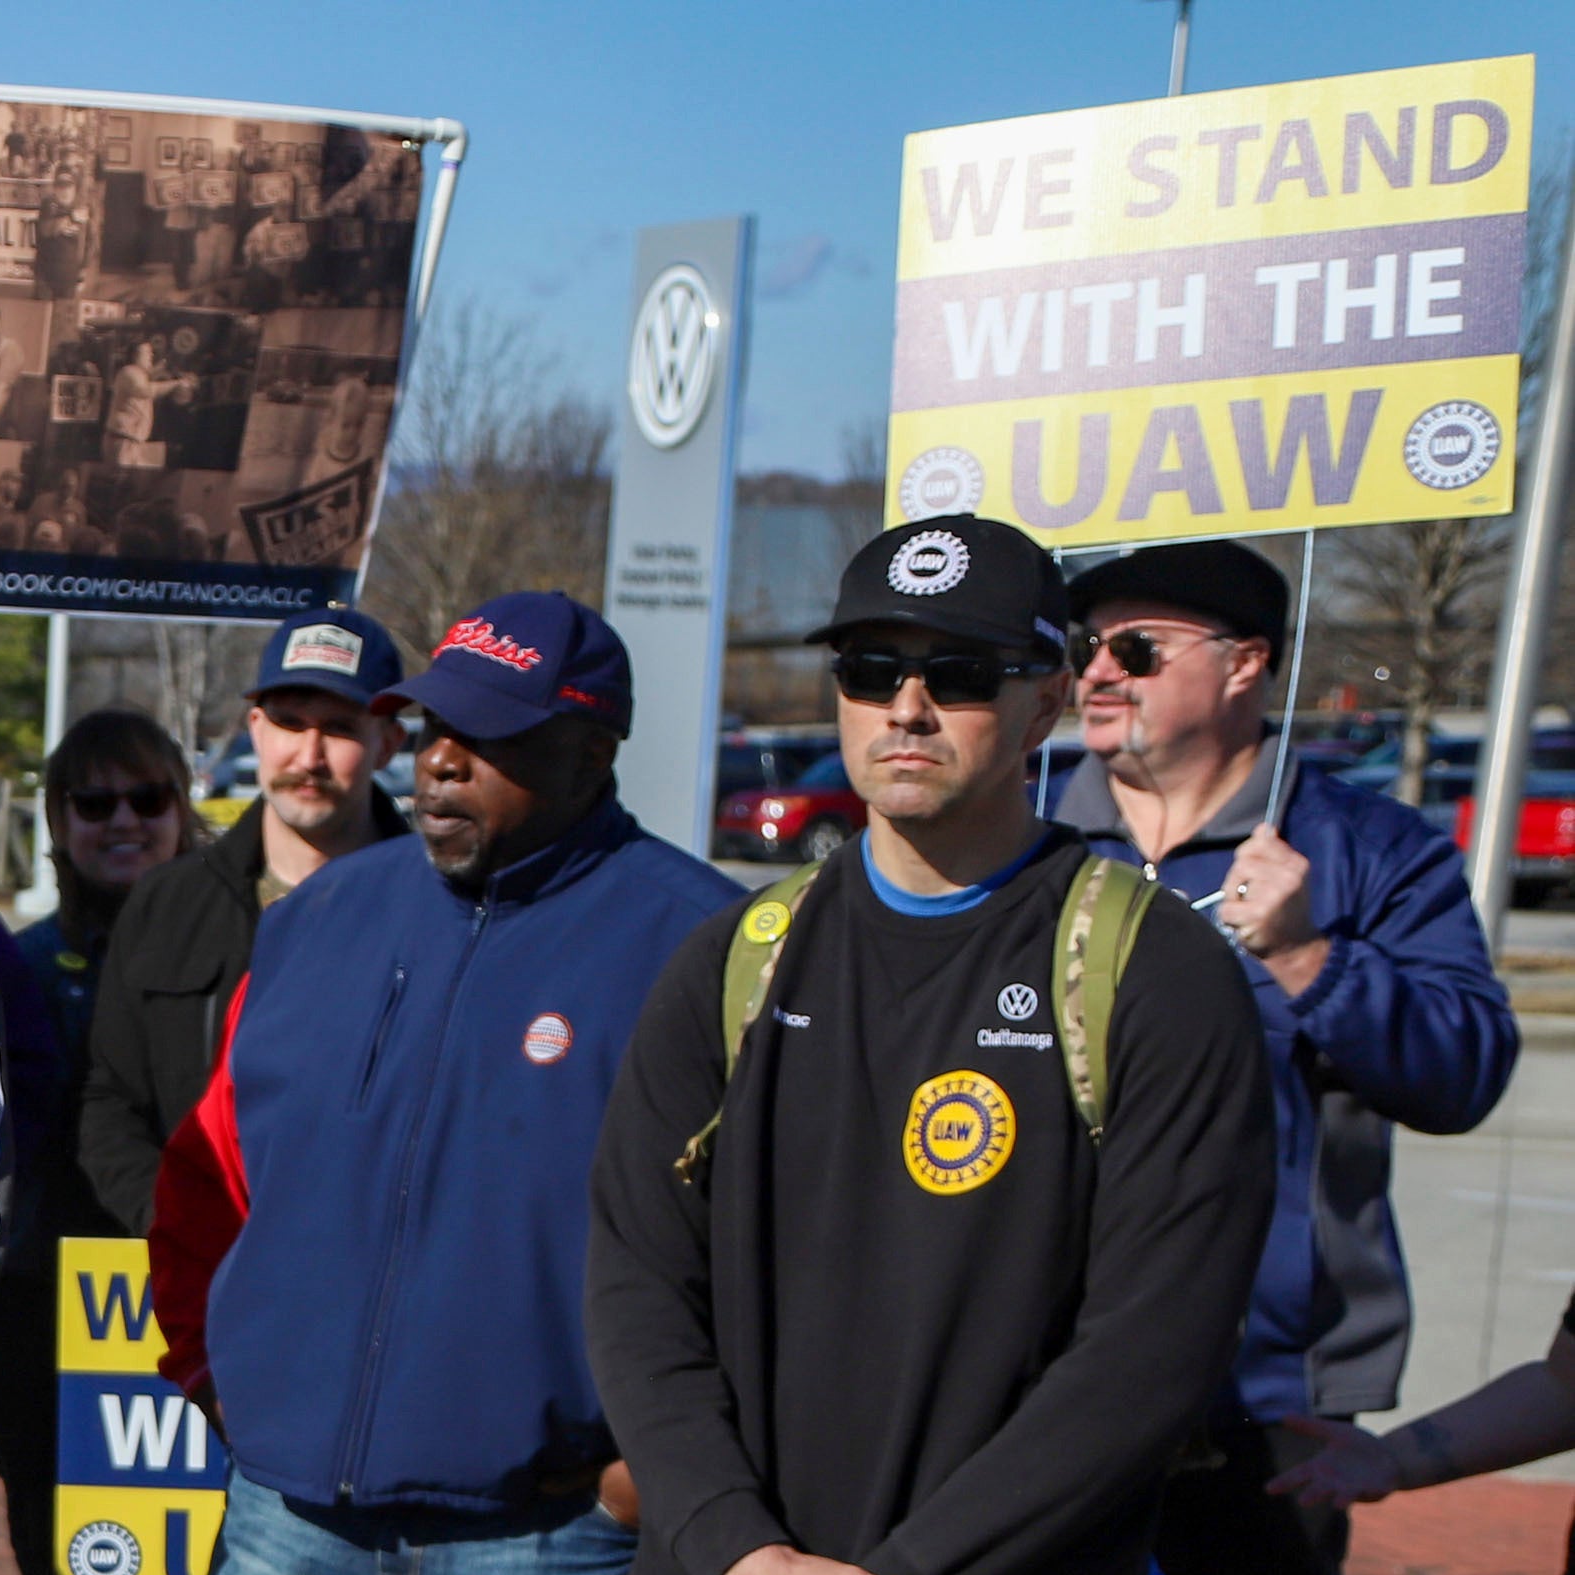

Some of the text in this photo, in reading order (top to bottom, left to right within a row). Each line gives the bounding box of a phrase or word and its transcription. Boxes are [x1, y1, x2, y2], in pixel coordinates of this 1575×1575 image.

[922, 99, 1509, 241] WE STAND
[942, 247, 1467, 381] WITH THE
[1011, 388, 1385, 531] UAW
[908, 552, 948, 572] UAW
[976, 1028, 1054, 1052] Chattanooga
[934, 1120, 974, 1143] UAW
[98, 1393, 207, 1473] WI
[88, 1547, 119, 1565] UAW
